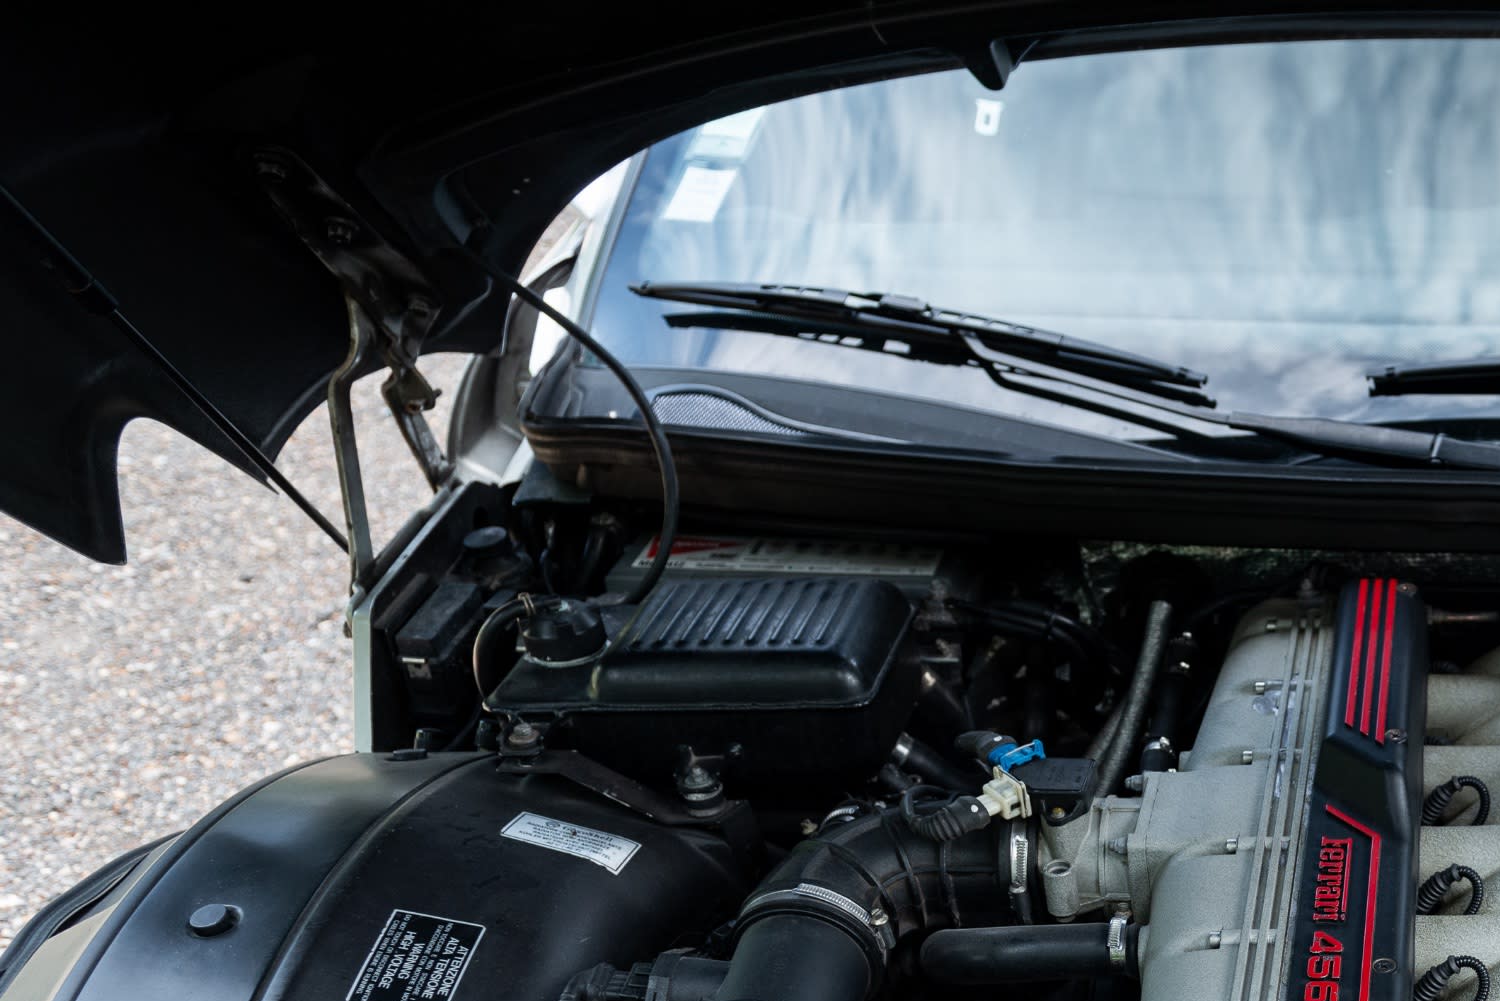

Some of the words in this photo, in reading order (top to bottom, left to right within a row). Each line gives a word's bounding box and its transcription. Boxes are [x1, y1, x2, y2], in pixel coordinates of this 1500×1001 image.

[1312, 836, 1352, 921] Ferrari
[398, 930, 417, 950] HIGH
[443, 936, 460, 955] ALTA
[378, 953, 405, 989] VOLTAGE
[397, 942, 425, 980] WARNING
[421, 958, 450, 999] TENSIONE
[437, 945, 469, 997] ATTENZIONE
